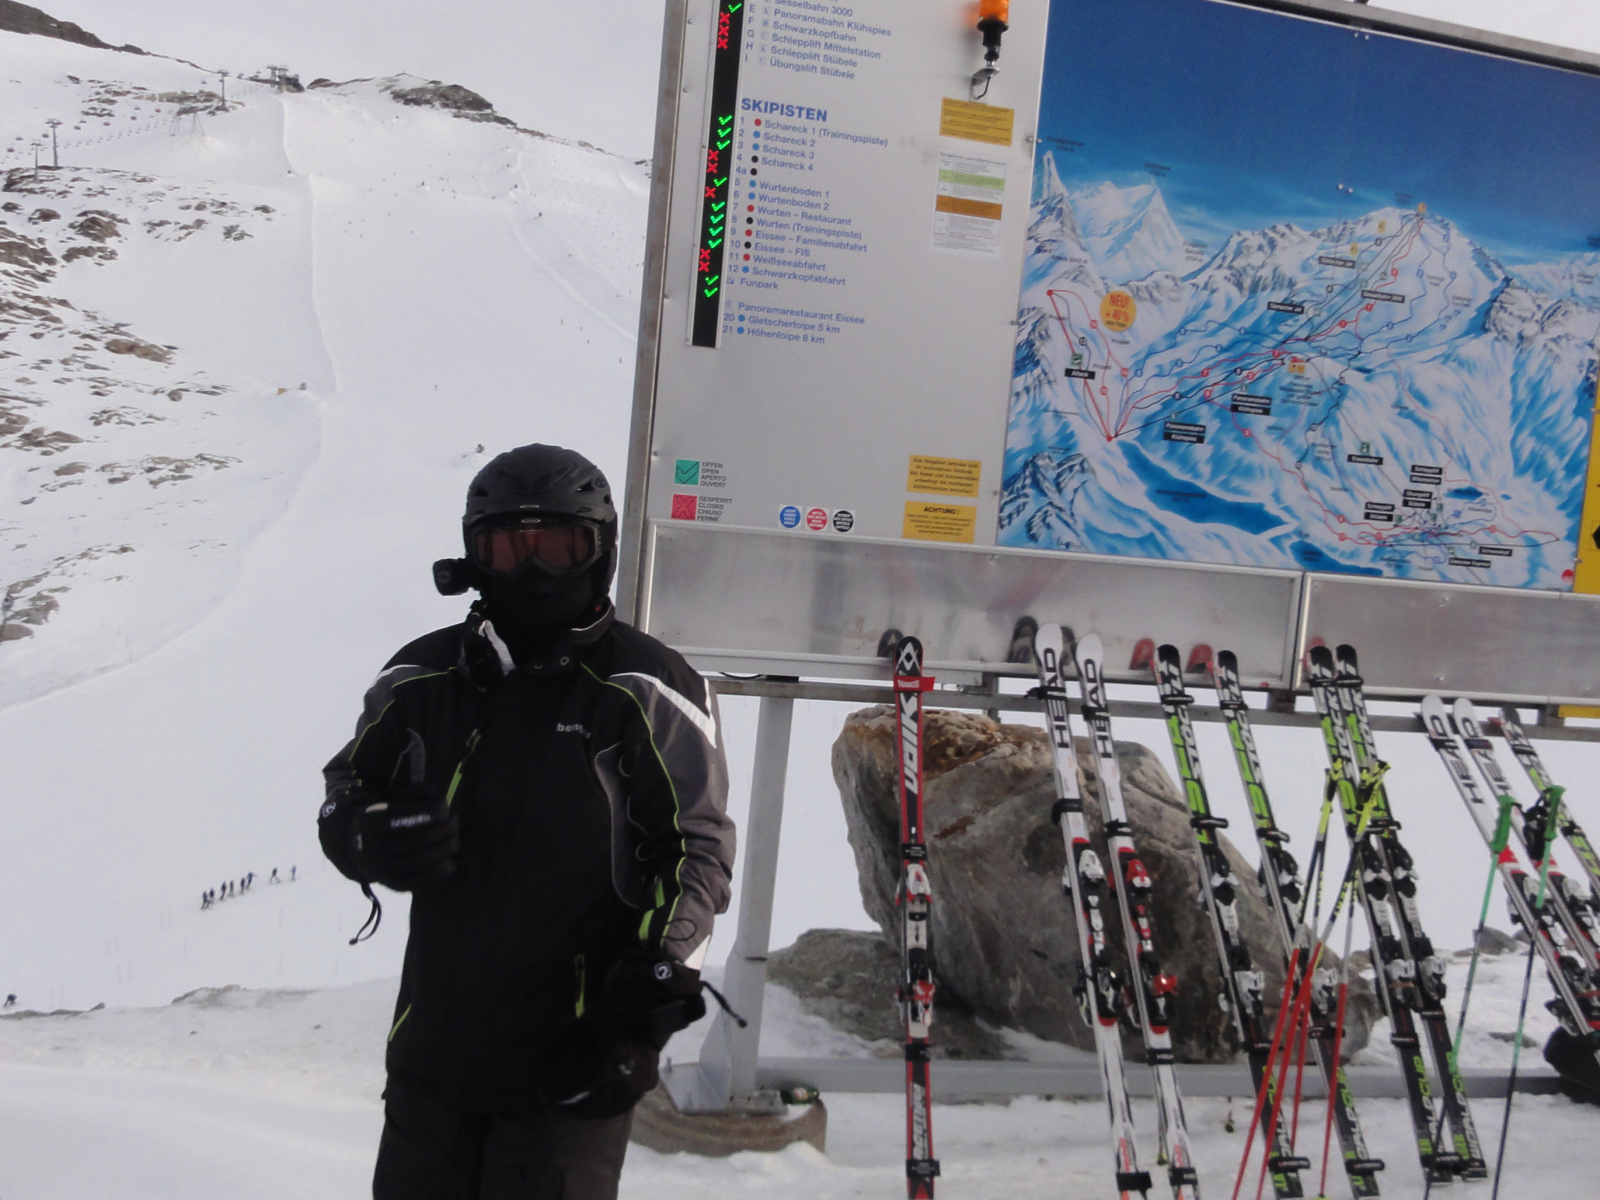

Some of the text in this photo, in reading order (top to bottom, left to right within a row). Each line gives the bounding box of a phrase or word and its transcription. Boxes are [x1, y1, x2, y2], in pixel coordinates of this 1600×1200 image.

[749, 4, 892, 37] E Panoramabahn Klühspies
[831, 6, 853, 17] 3000
[748, 17, 857, 43] F Schwarzkopfbahn
[745, 42, 858, 68] H Schlepplift Stübele
[747, 29, 882, 60] G Schlepplift Mittelstation
[769, 55, 818, 74] Übungslift
[820, 66, 855, 80] Stübele
[741, 98, 828, 122] SKIPISTEN
[738, 129, 816, 148] 2 Schareck 2
[764, 119, 808, 134] Schareck
[818, 128, 889, 148] (Trainingspiste)
[737, 141, 815, 160] 3 Schareck 3
[735, 166, 747, 175] 4a
[736, 153, 814, 172] 4 Schareck 4
[734, 178, 741, 187] 5
[759, 181, 822, 198] Wurtenboden
[733, 190, 830, 211] 6 Wurtenboden 2
[732, 202, 738, 211] 7
[757, 205, 791, 219] Wurten
[801, 211, 852, 227] Restaurant
[731, 215, 862, 241] 8 Wurten (Trainingspiste)
[729, 239, 741, 249] 10
[754, 242, 785, 255] Eissee
[795, 247, 811, 258] FIS
[730, 227, 737, 236] 9
[755, 229, 787, 243] Eissee
[796, 235, 868, 253] Familienabfahrt
[728, 252, 827, 271] 11 Weißseeabfahrt
[728, 264, 847, 286] 12 Schwarzkopfabfahrt
[740, 277, 779, 291] Funpark
[723, 312, 840, 334] 20 Gletscherloipe 5 km
[738, 302, 866, 325] Panoramarestaurant Eissee
[722, 325, 826, 344] 21 Höhenloipe 8 km
[702, 461, 723, 469] OFFEN
[700, 474, 727, 482] APERTO
[700, 480, 727, 488] OUVERT
[698, 502, 724, 510] CLOSED
[699, 495, 733, 504] GESPERRT
[697, 508, 722, 516] CHIUSO
[1044, 647, 1069, 748] HEAD
[1084, 658, 1112, 759] HEAD
[1430, 715, 1483, 804] HEAD
